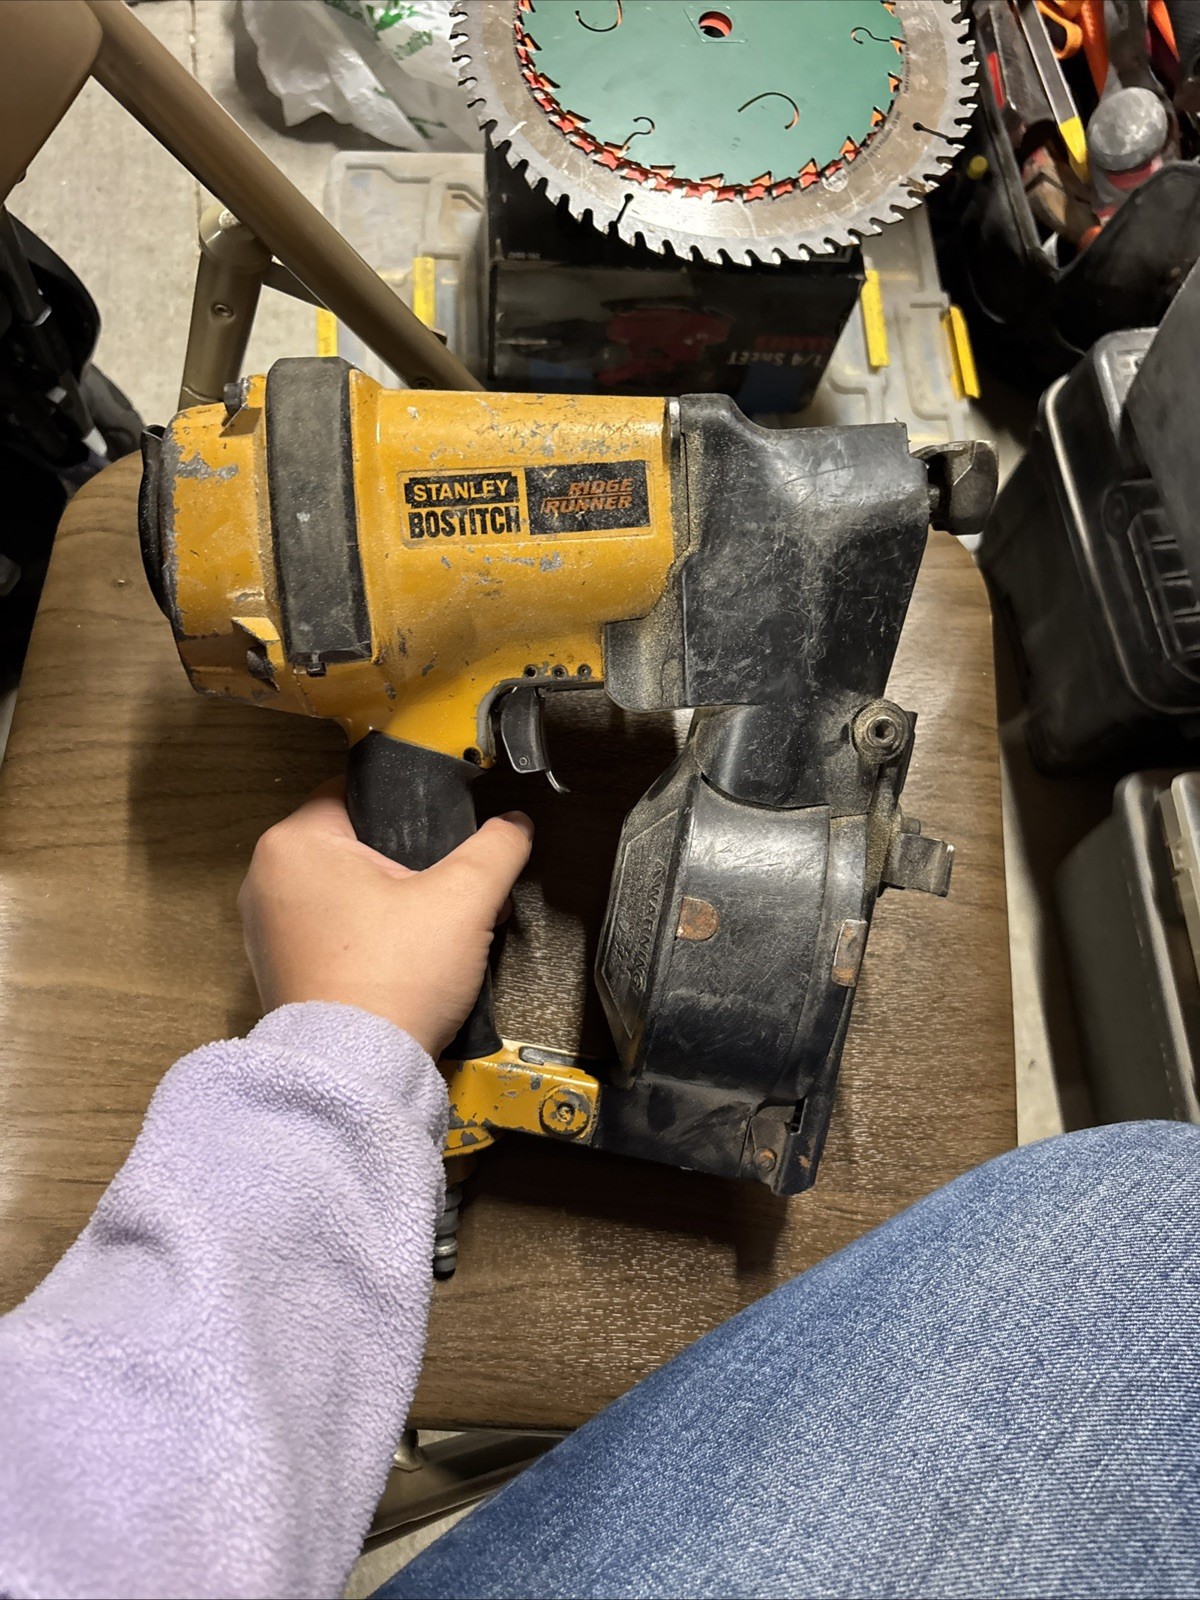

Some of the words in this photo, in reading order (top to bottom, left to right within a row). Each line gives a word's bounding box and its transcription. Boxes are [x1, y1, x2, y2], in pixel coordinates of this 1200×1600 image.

[413, 480, 508, 502] STANLEY
[568, 477, 634, 497] RIDGE
[544, 496, 632, 514] RUNNER
[408, 506, 520, 538] BOSTITCH
[632, 884, 661, 992] WARNING
